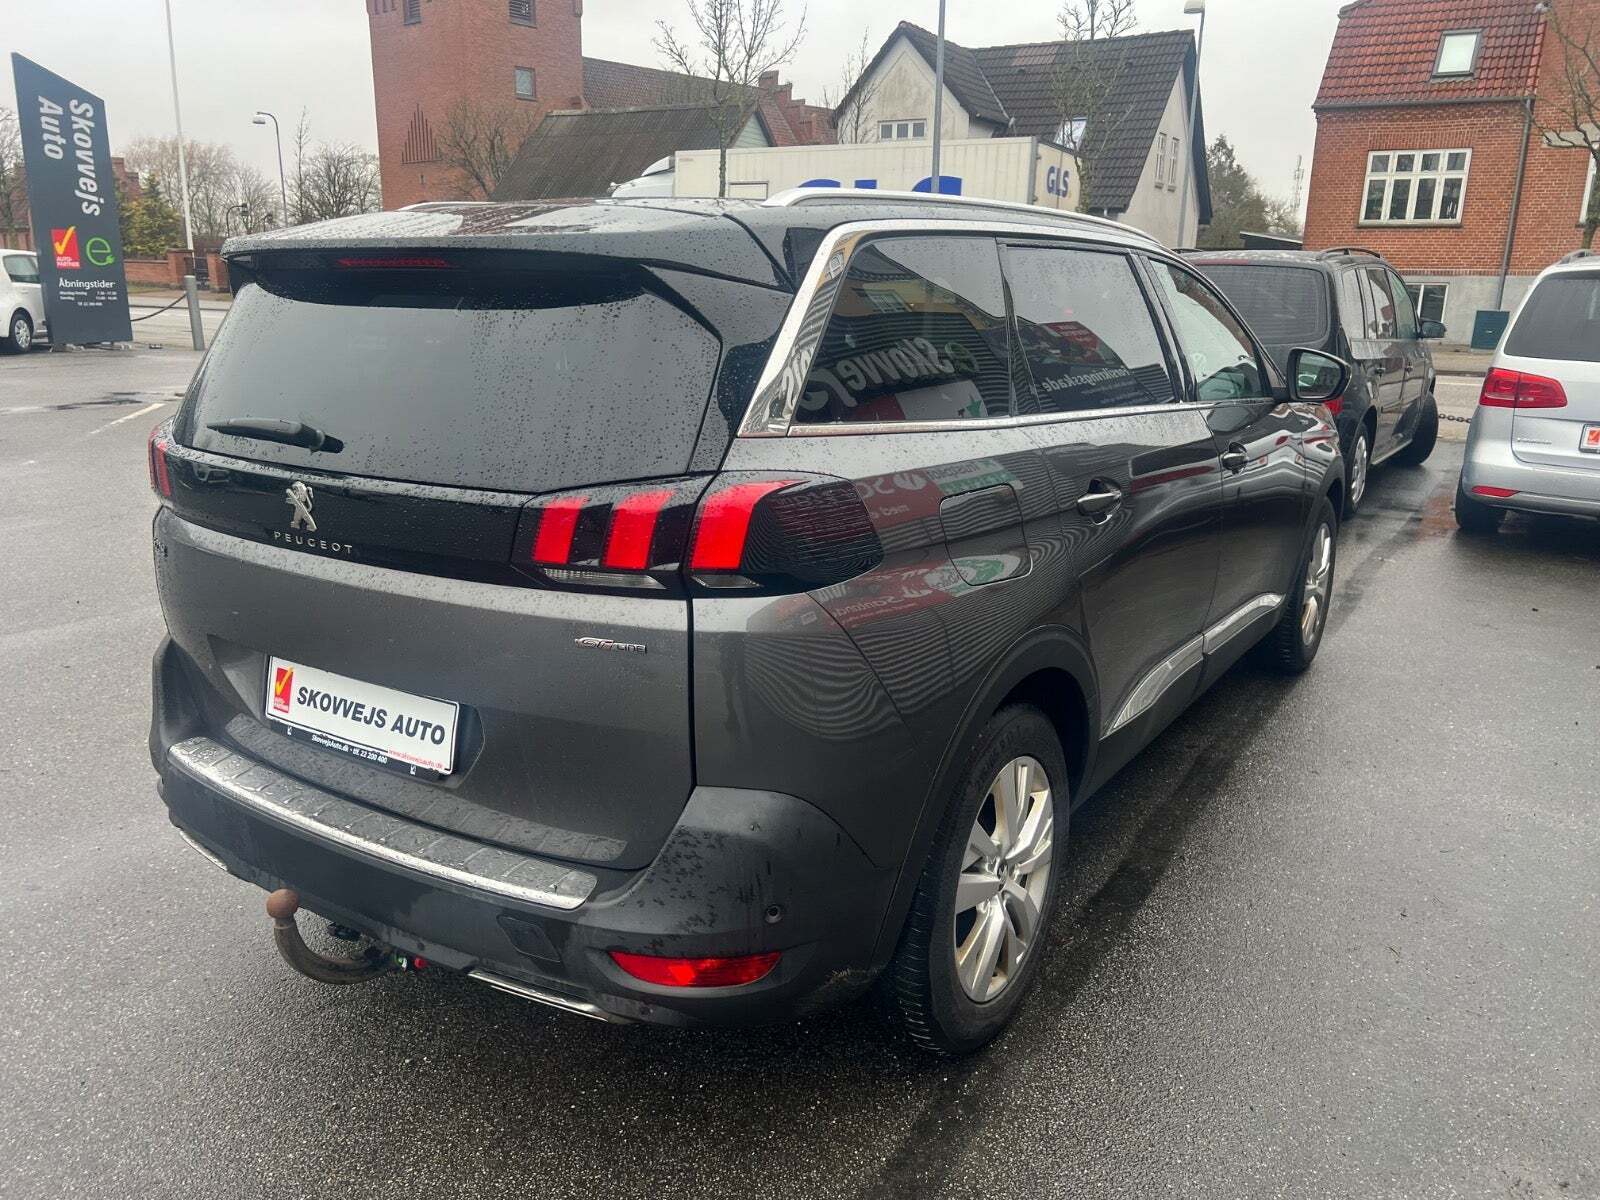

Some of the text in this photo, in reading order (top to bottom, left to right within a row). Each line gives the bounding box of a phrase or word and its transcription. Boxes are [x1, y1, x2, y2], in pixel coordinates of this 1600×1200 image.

[37, 95, 67, 160] Auto
[69, 98, 104, 217] Skovvejs
[1045, 165, 1071, 199] GLS
[273, 531, 353, 555] PEUGEOT
[296, 686, 388, 729] SKOVVEJS
[390, 713, 446, 746] AUTO
